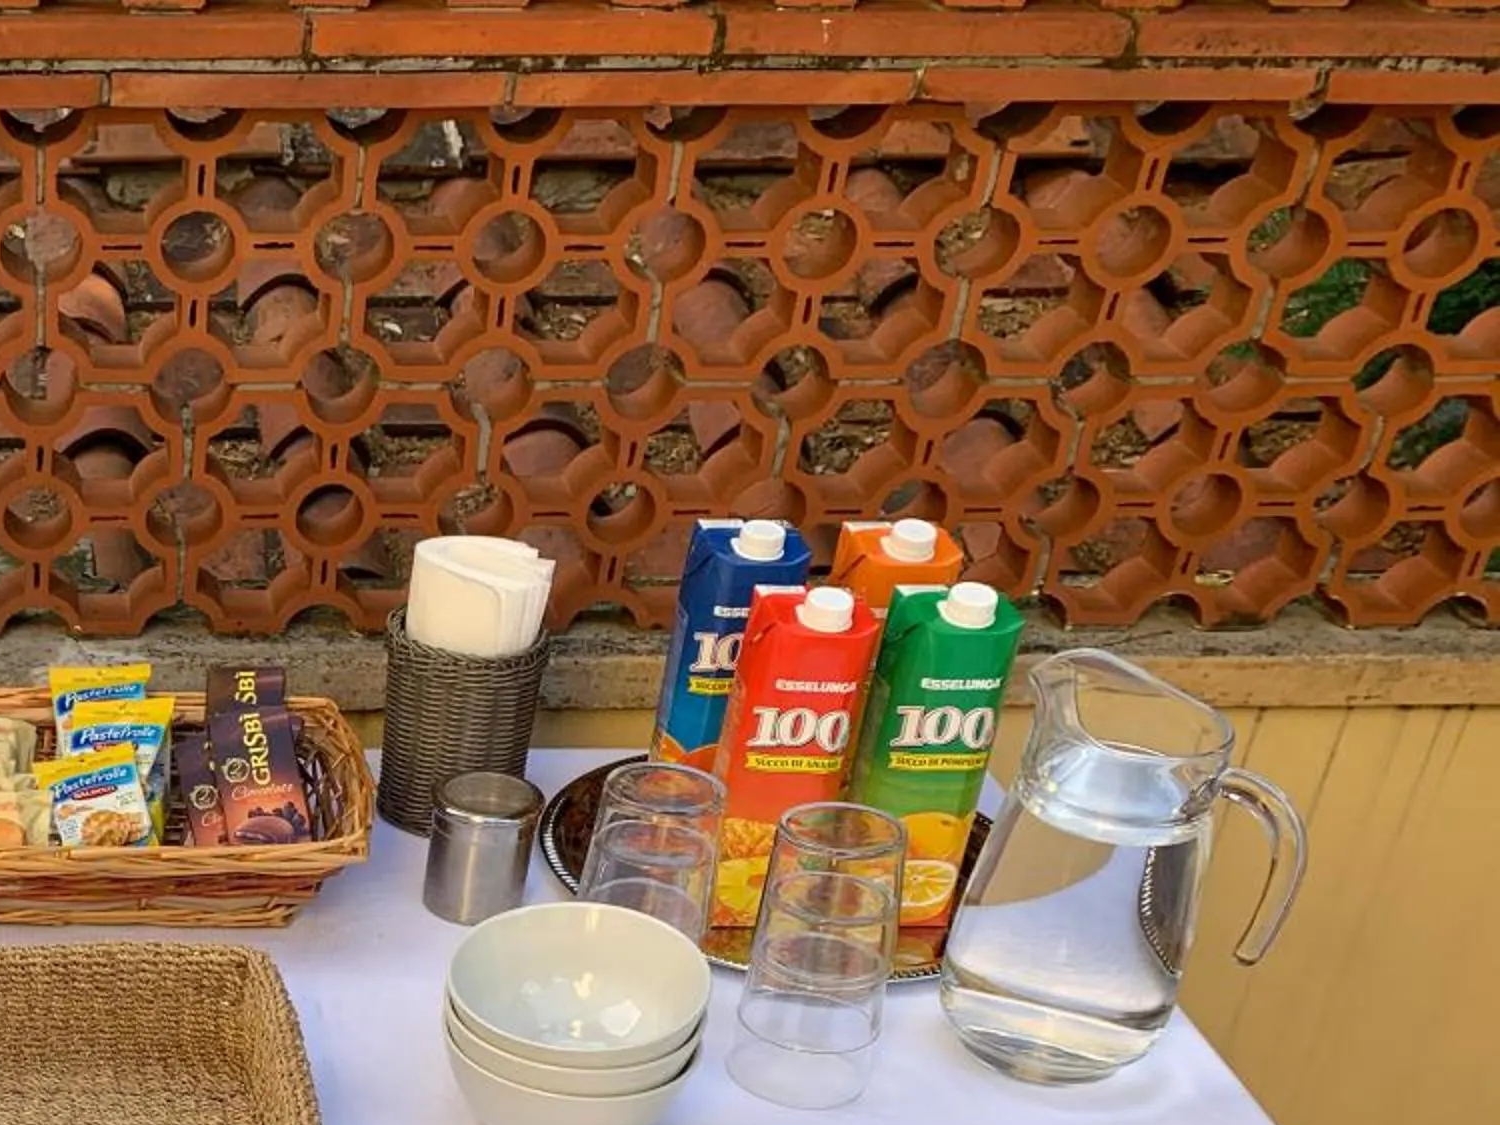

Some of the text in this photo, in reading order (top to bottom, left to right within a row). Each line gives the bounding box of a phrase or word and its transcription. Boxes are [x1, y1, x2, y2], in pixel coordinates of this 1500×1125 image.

[689, 632, 745, 672] 10
[774, 678, 857, 694] ESSELUNGA
[920, 677, 1003, 691] ESSELUNGA
[746, 706, 851, 753] 100
[890, 705, 995, 750] 100
